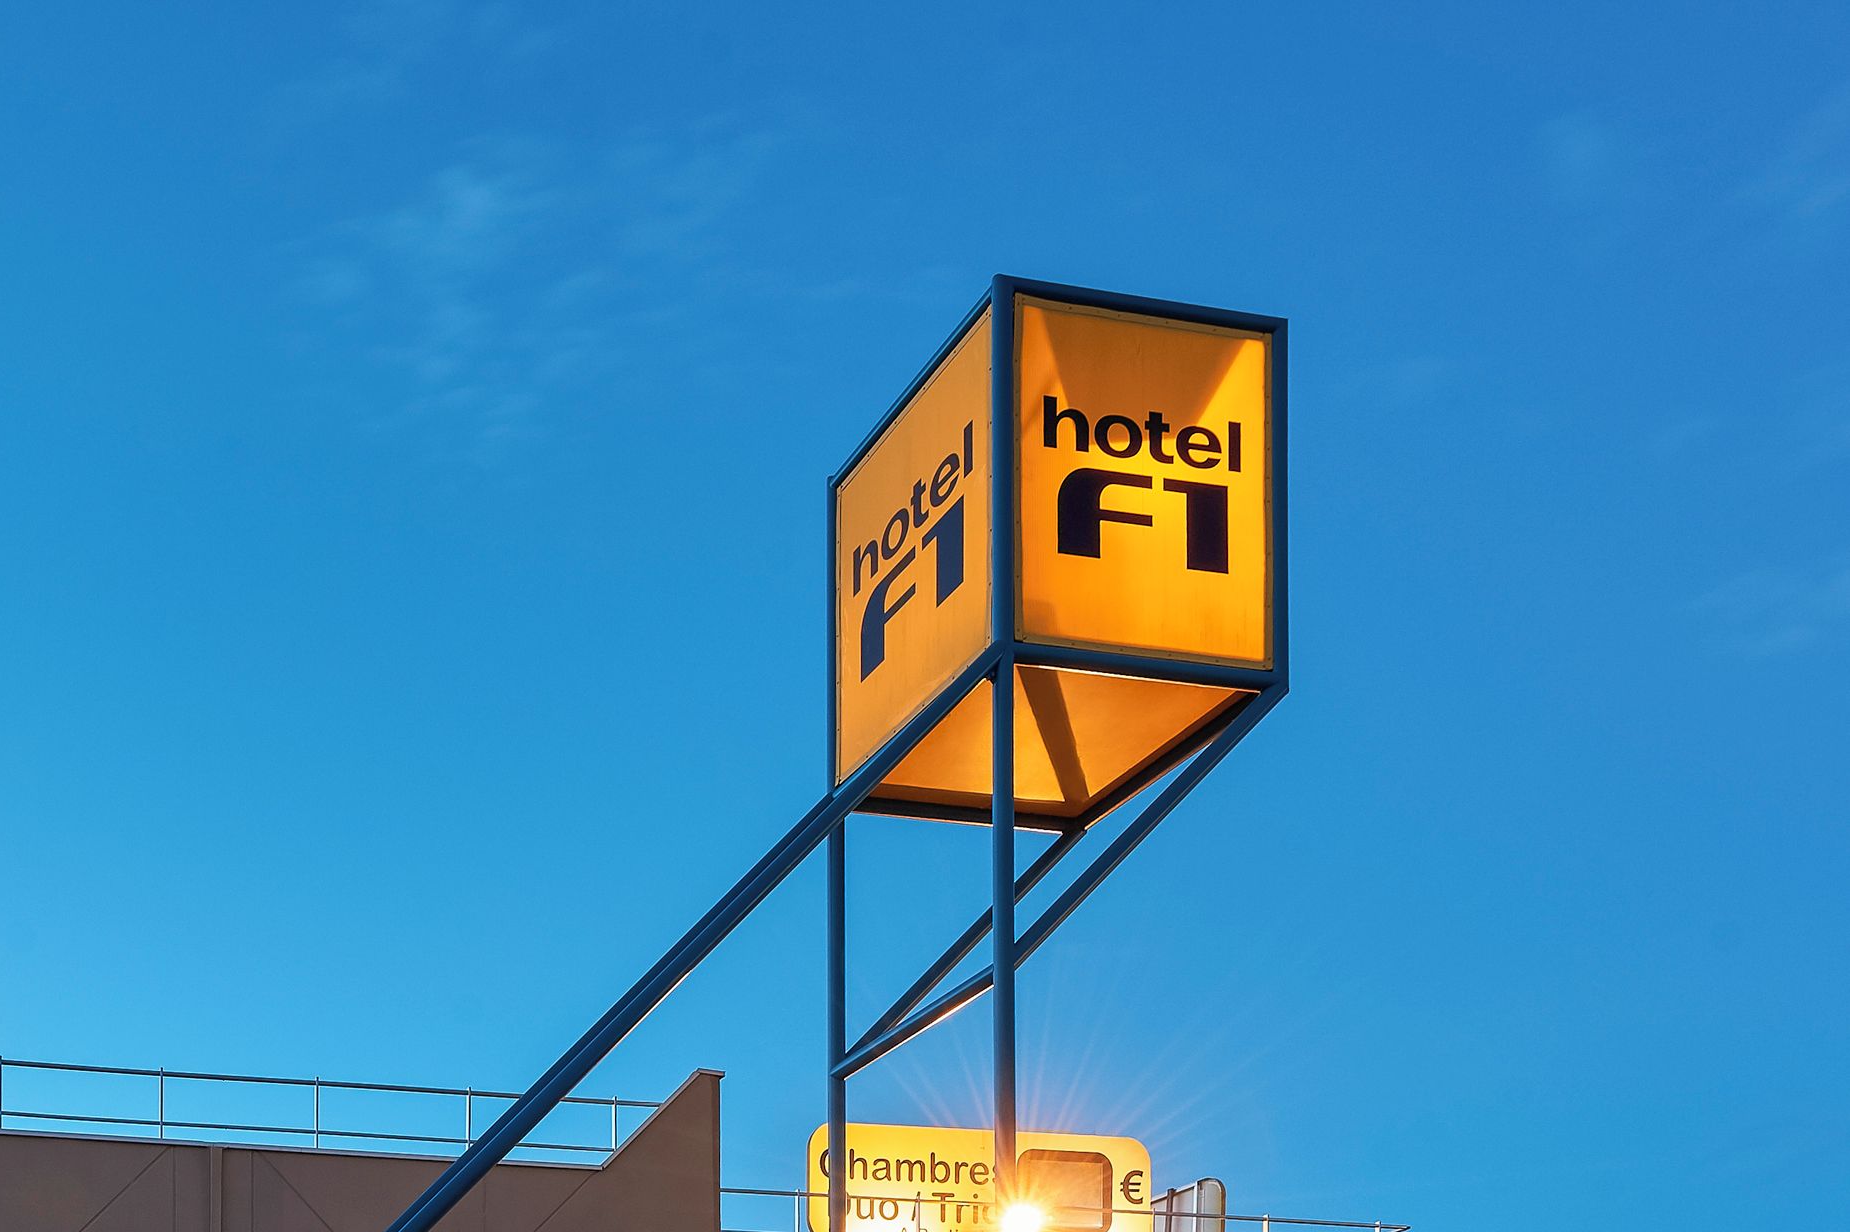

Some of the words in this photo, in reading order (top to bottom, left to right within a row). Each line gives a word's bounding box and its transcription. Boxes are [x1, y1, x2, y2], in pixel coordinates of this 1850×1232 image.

[1043, 395, 1242, 473] hotel
[852, 420, 974, 598] hotel
[1057, 467, 1229, 575] F1
[860, 494, 965, 683] F1
[846, 1191, 899, 1221] uo
